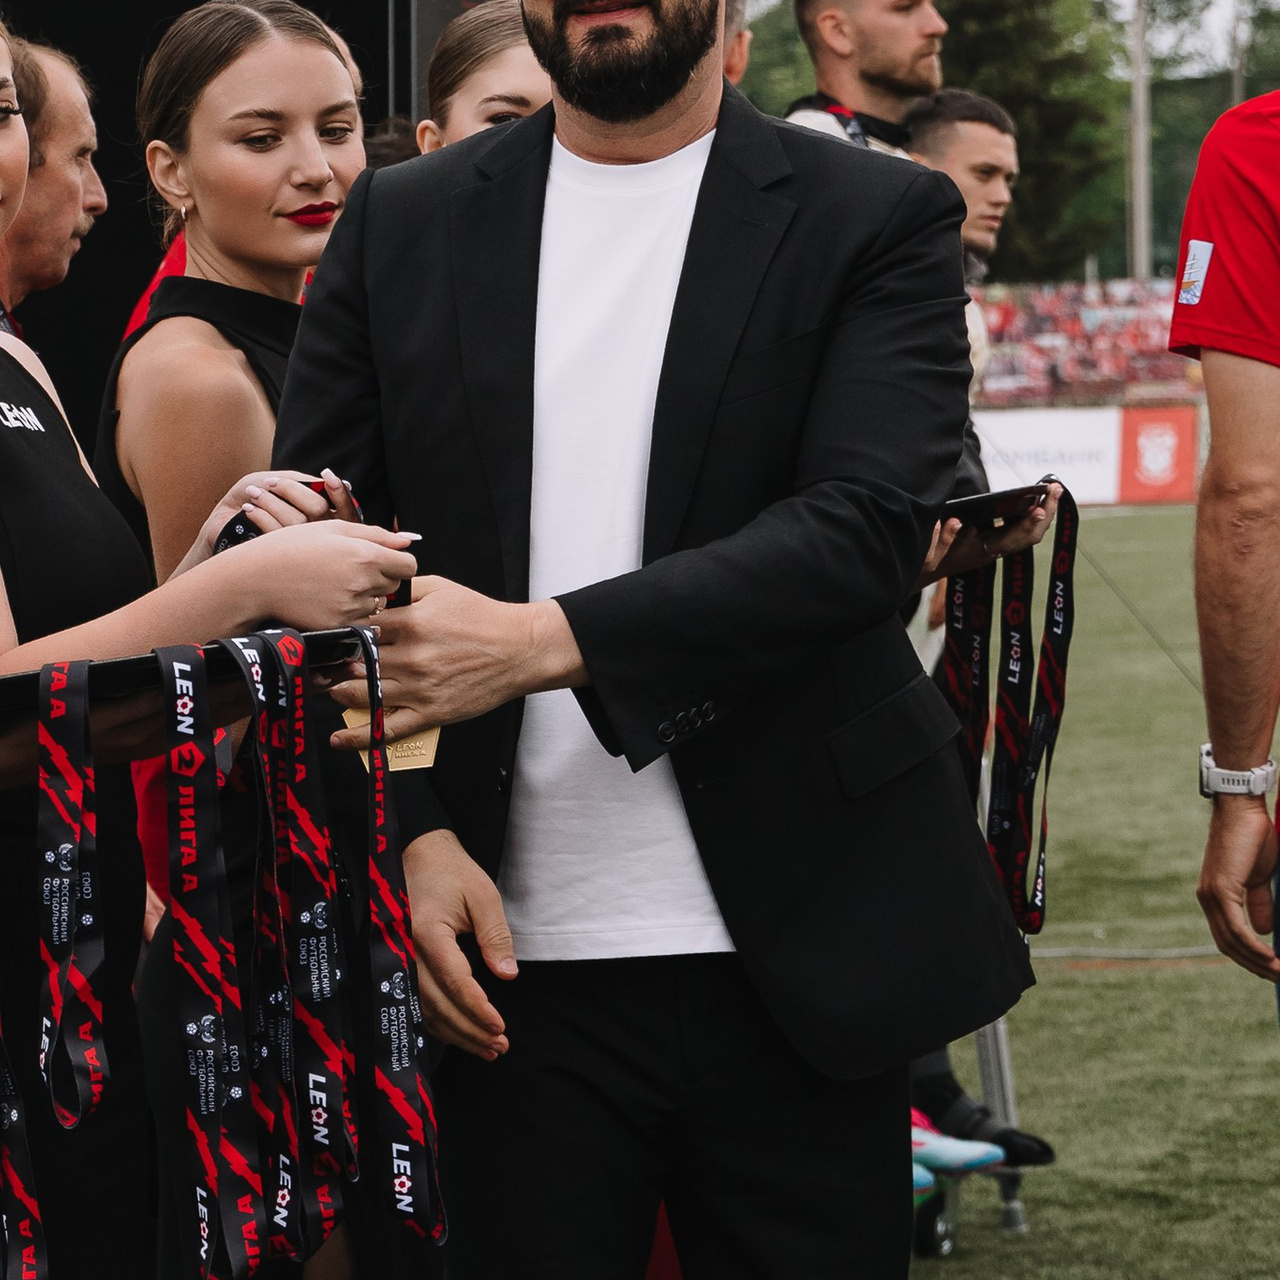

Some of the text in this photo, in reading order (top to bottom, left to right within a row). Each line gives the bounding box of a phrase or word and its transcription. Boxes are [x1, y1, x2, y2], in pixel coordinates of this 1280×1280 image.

[1053, 581, 1065, 635] LEON
[50, 662, 70, 719] ГА А
[1008, 631, 1021, 684] LEON
[293, 676, 306, 756] ЛИГА
[173, 661, 198, 893] LEON 2 ЛИГА А
[294, 762, 307, 783] А
[380, 1007, 389, 1035] СОЮЗ
[389, 1006, 401, 1072] ФУТБОЛЬНЫЙ
[398, 1005, 411, 1068] РОССИЙСКИЙ
[83, 1047, 104, 1113] ИГА
[308, 1072, 330, 1145] LEON
[273, 1153, 292, 1228] LEON
[392, 1142, 414, 1213] LEON
[18, 1218, 33, 1238] А
[196, 1186, 209, 1261] LEON
[237, 1193, 261, 1277] ИГА А
[316, 1183, 335, 1241] ИГА
